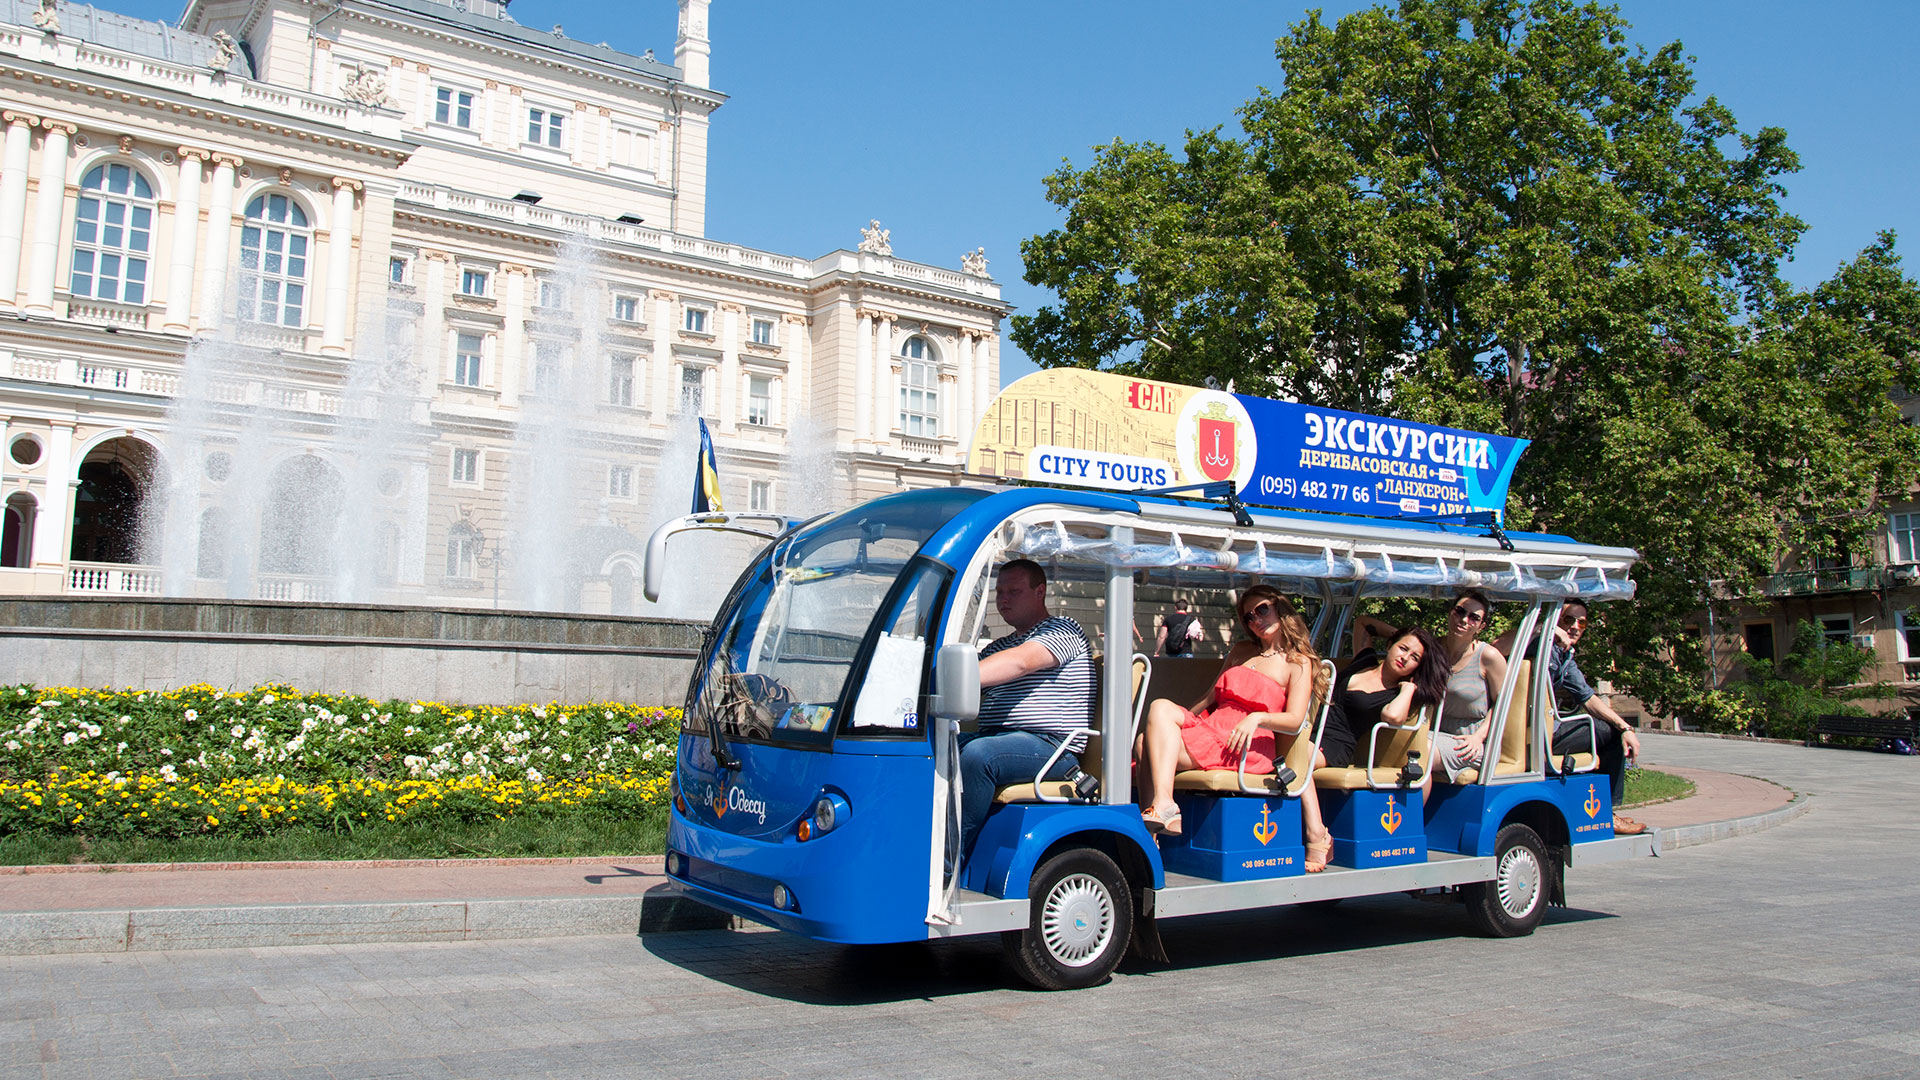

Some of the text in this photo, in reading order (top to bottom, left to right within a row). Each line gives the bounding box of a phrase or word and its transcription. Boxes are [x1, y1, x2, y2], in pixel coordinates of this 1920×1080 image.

[1138, 383, 1176, 414] CAR
[1304, 412, 1490, 470] ЭКСКУРСИИ
[1039, 454, 1167, 487] CITY TOURS
[1299, 448, 1428, 480] ДЕРИБАСОВСКАЯ
[1260, 474, 1370, 503] (095) 482 77 66
[1384, 478, 1459, 502] ЛАНЖЕРОН
[1438, 502, 1502, 523] АРКАЯ
[904, 713, 917, 727] 13
[704, 784, 766, 825] Я Одессу
[1242, 857, 1293, 868] +38 095 482 77 66
[1392, 848, 1401, 856] 482
[1402, 847, 1408, 855] 77
[1409, 847, 1416, 855] 66
